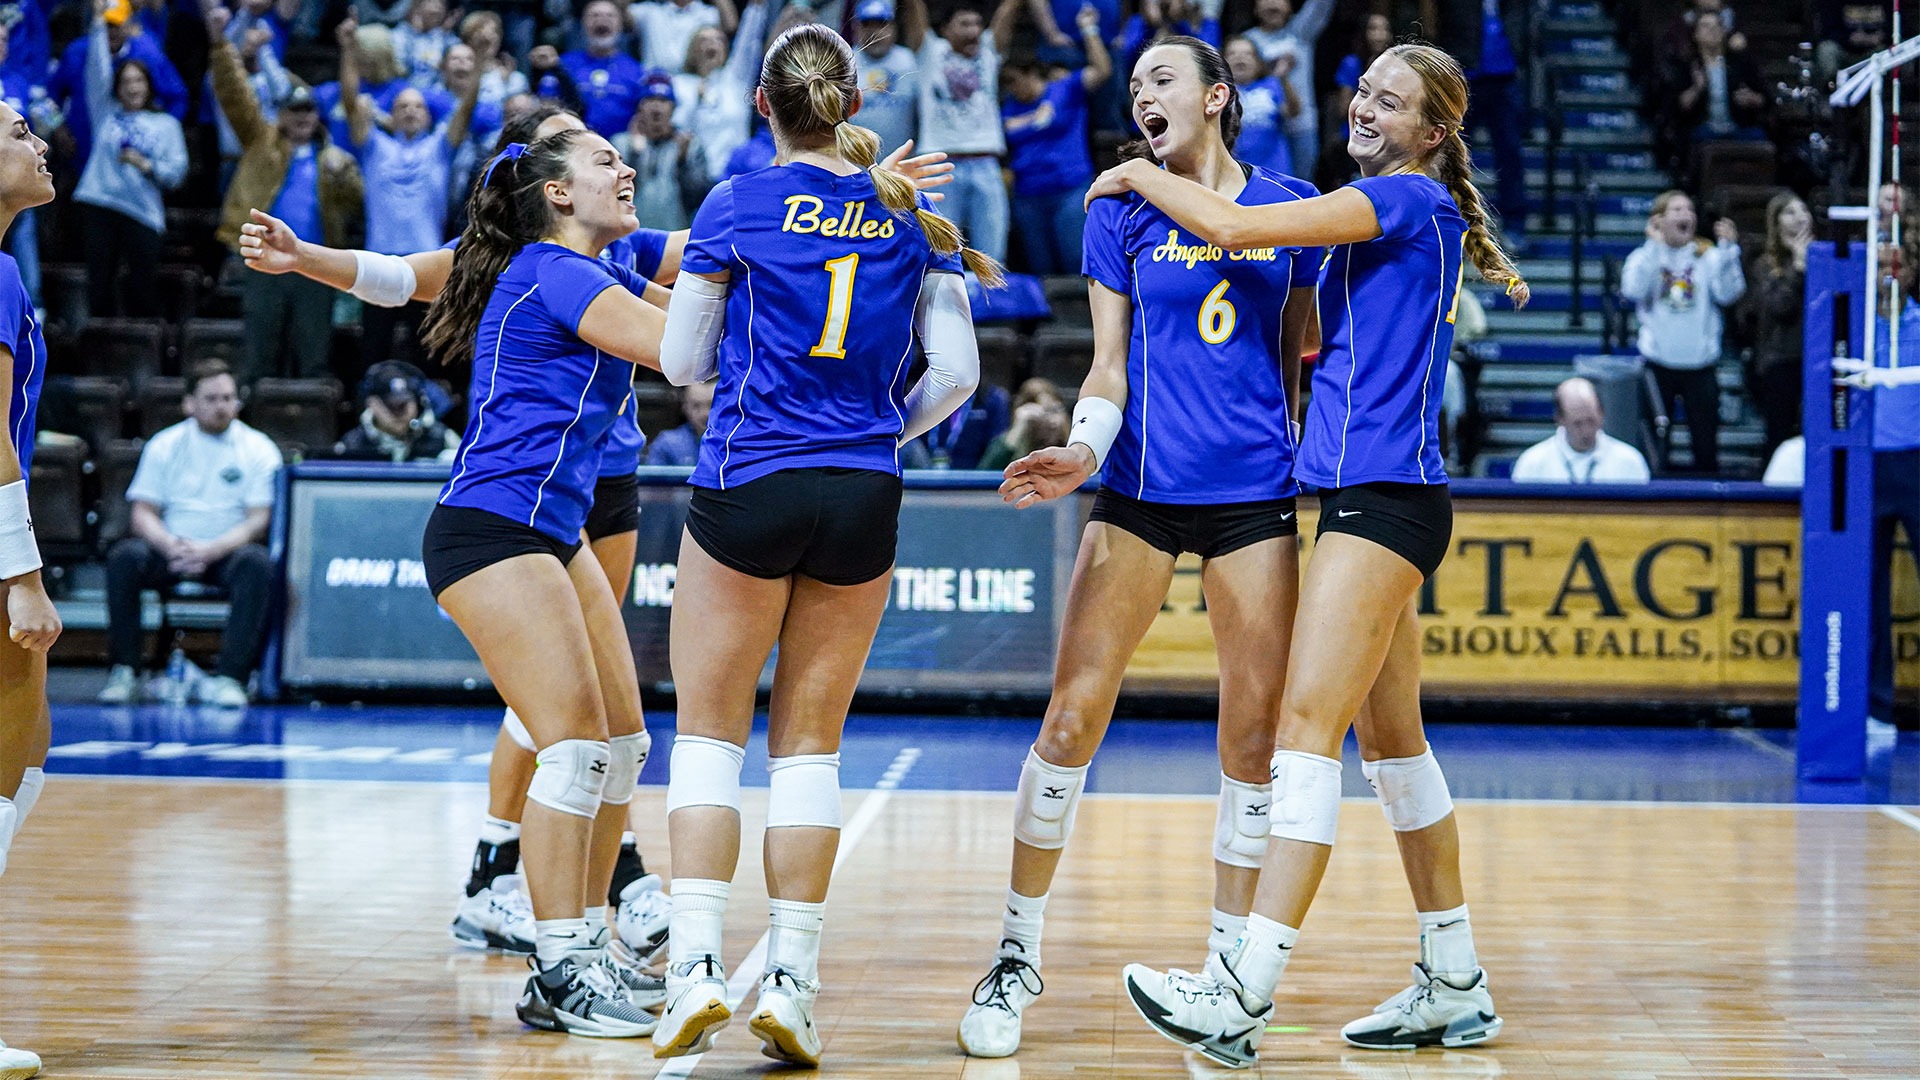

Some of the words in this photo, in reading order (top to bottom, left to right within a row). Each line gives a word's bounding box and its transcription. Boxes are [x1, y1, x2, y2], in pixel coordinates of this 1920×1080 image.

[782, 195, 895, 239] Belles
[1152, 229, 1223, 270] Angelo
[809, 252, 860, 360] 1
[1198, 278, 1237, 345] 6
[894, 566, 957, 612] THE
[958, 567, 1036, 613] LINE
[1421, 624, 1560, 658] SIOUX
[1573, 626, 1714, 664] FALLS,
